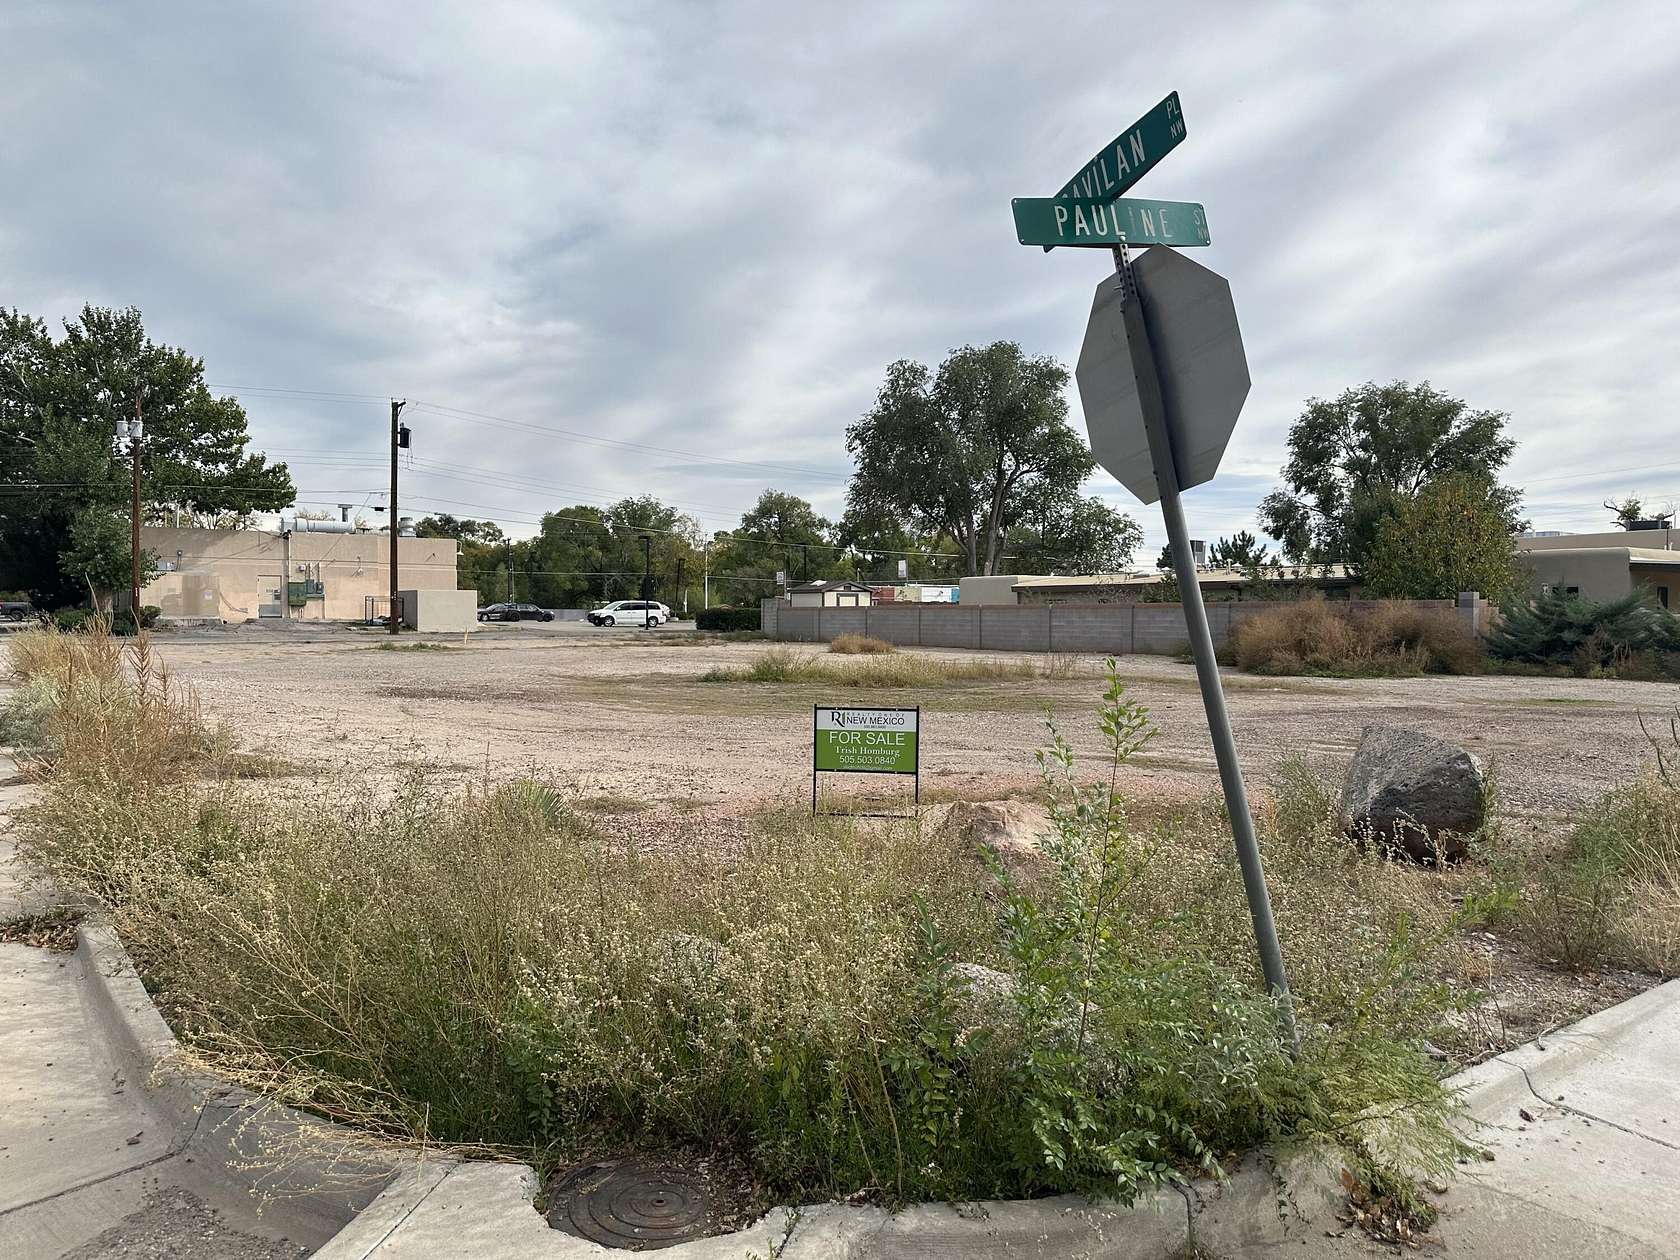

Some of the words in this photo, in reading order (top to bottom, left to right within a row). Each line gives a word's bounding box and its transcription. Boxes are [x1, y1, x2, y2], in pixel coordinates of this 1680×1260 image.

[1170, 119, 1183, 139] NW
[1062, 129, 1146, 198] AVILAN
[1166, 98, 1180, 120] PL
[1054, 205, 1173, 238] PAULINE
[1193, 208, 1206, 225] ST
[847, 716, 867, 725] NEW
[869, 717, 905, 726] MEXICO
[829, 731, 861, 744] FOR
[866, 732, 905, 746] SALE
[860, 747, 900, 758] Homburg
